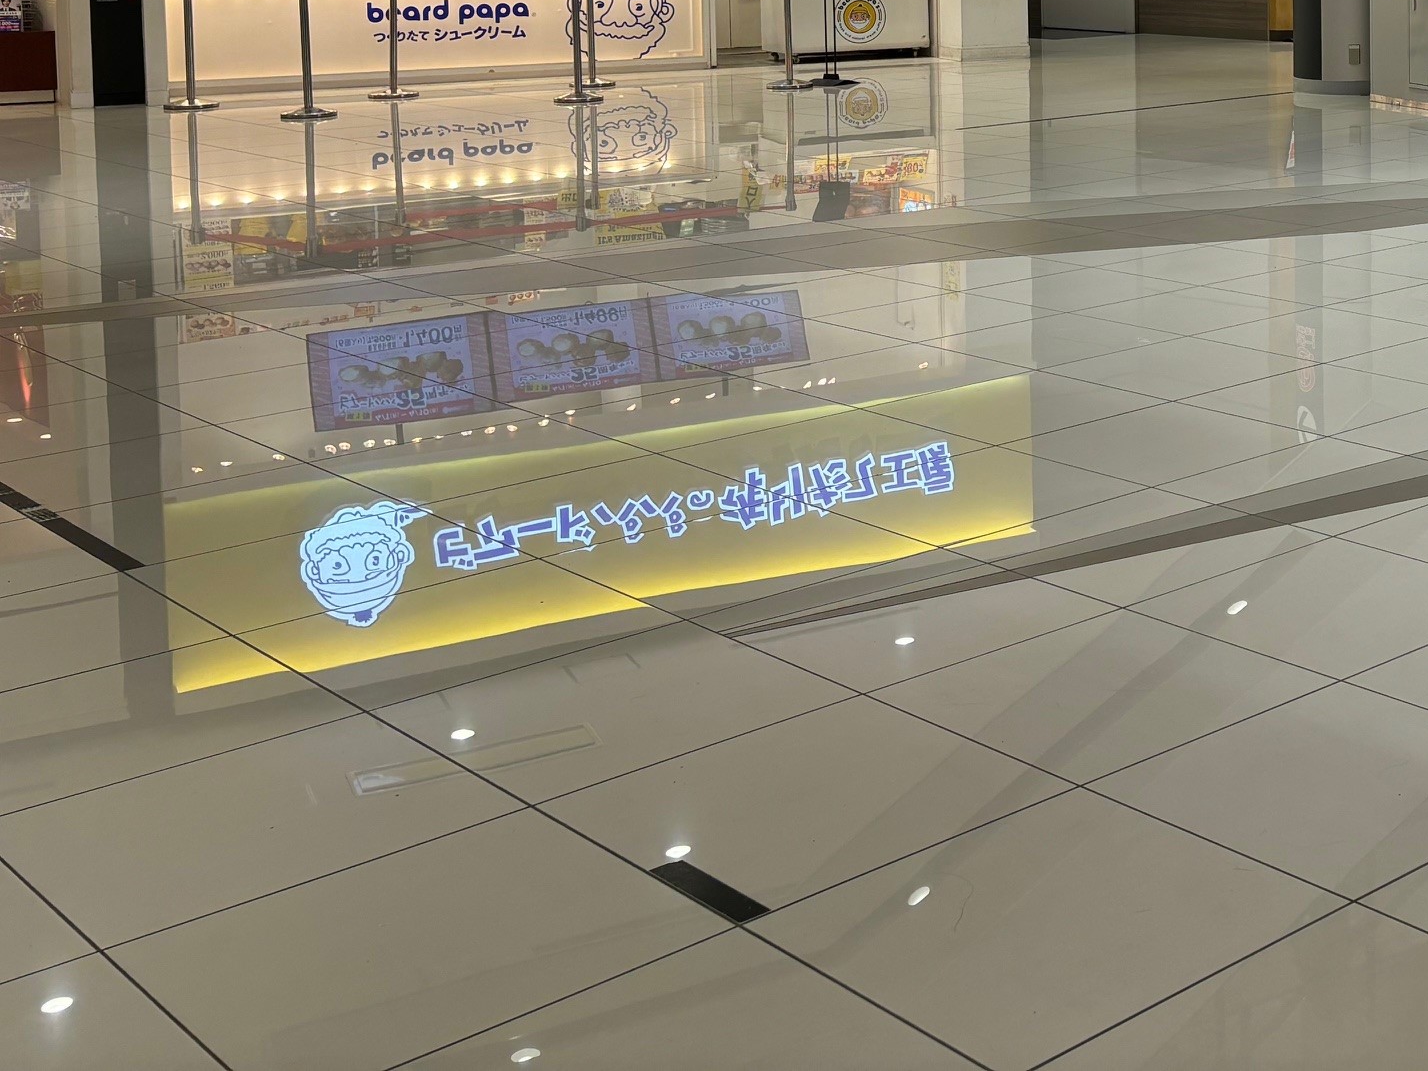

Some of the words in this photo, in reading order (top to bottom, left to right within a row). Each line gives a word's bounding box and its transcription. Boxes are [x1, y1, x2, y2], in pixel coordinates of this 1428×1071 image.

[458, 2, 530, 25] papa
[373, 30, 430, 43] つりたて
[434, 25, 527, 42] シュークリーム
